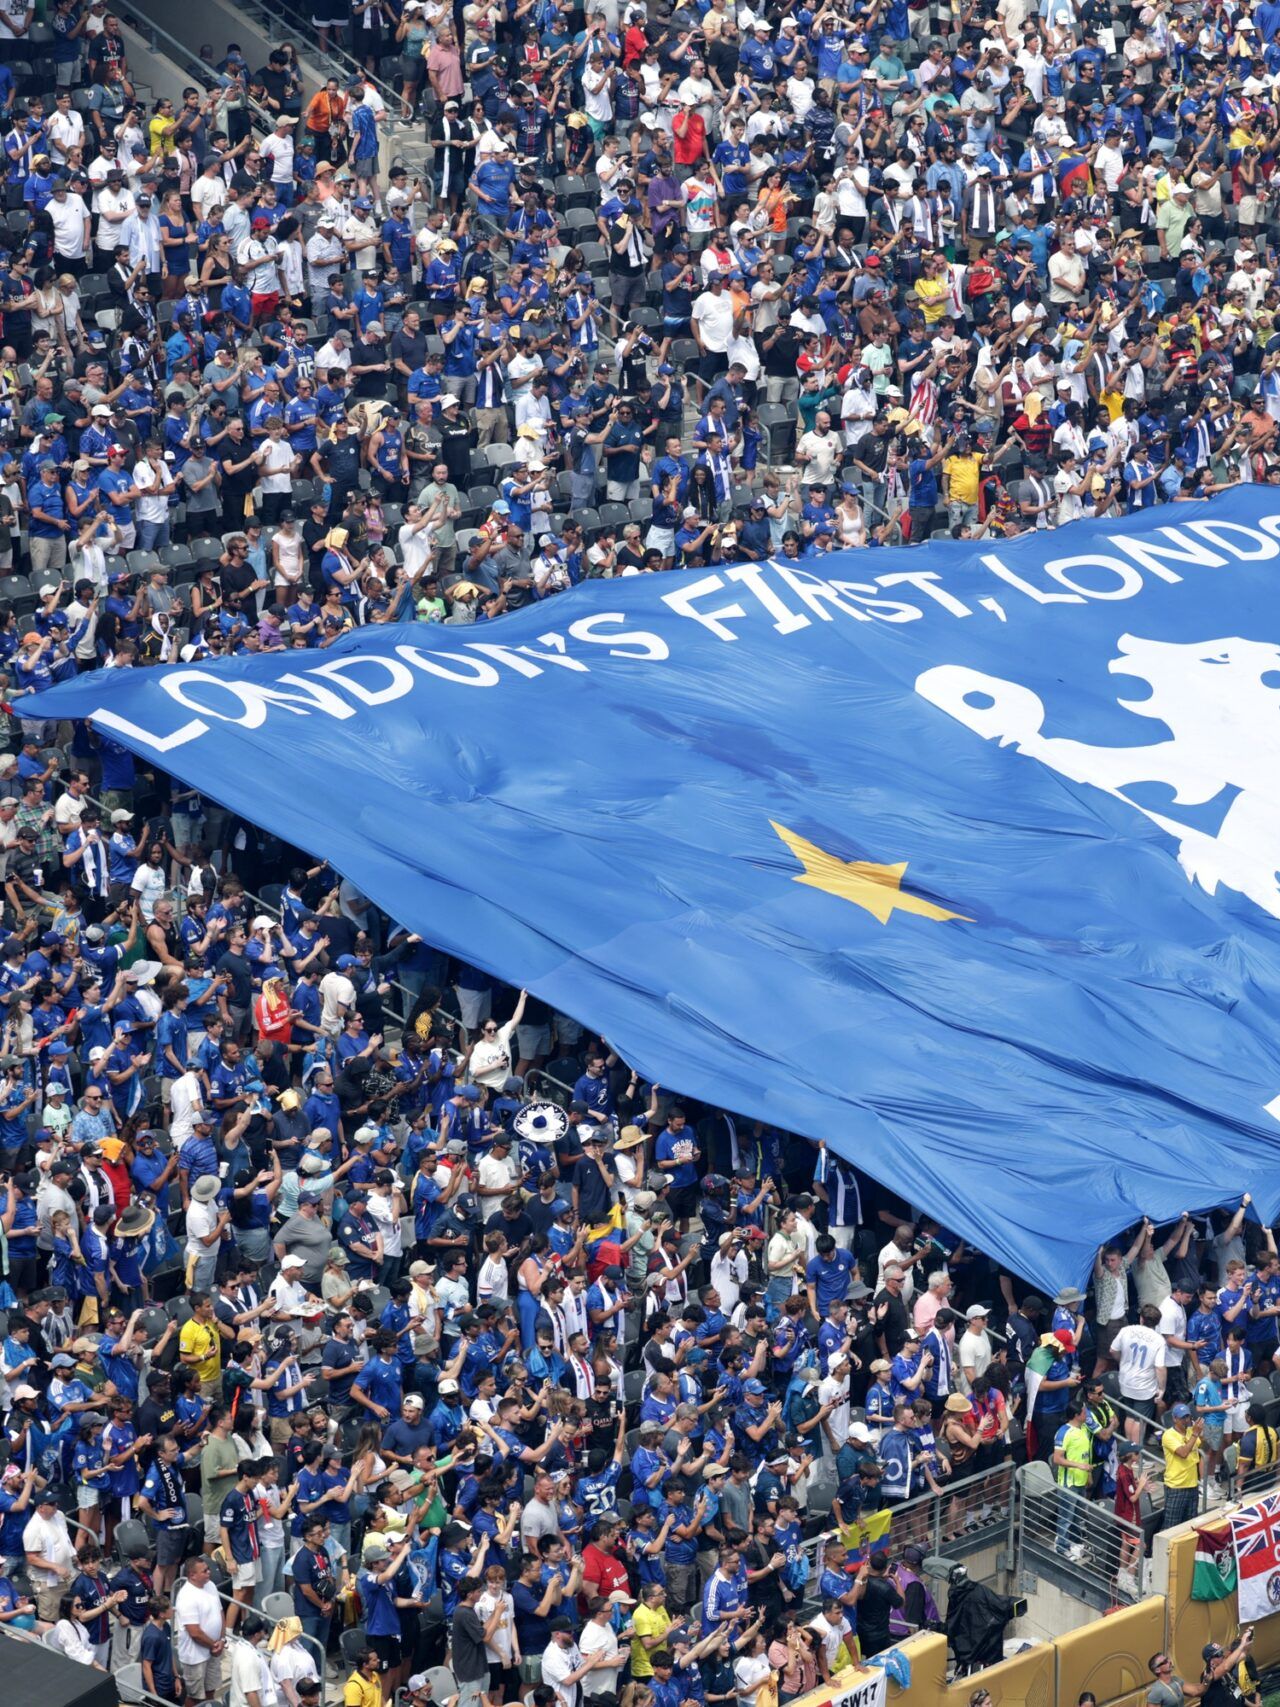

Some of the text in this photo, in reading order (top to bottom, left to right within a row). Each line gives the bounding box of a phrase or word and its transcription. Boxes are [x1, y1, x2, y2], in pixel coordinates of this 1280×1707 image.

[88, 613, 670, 752] LONDON'S
[660, 556, 1008, 641] FIRST,
[1130, 1342, 1148, 1369] 11
[585, 1486, 616, 1514] 20
[841, 1682, 878, 1707] SW17
